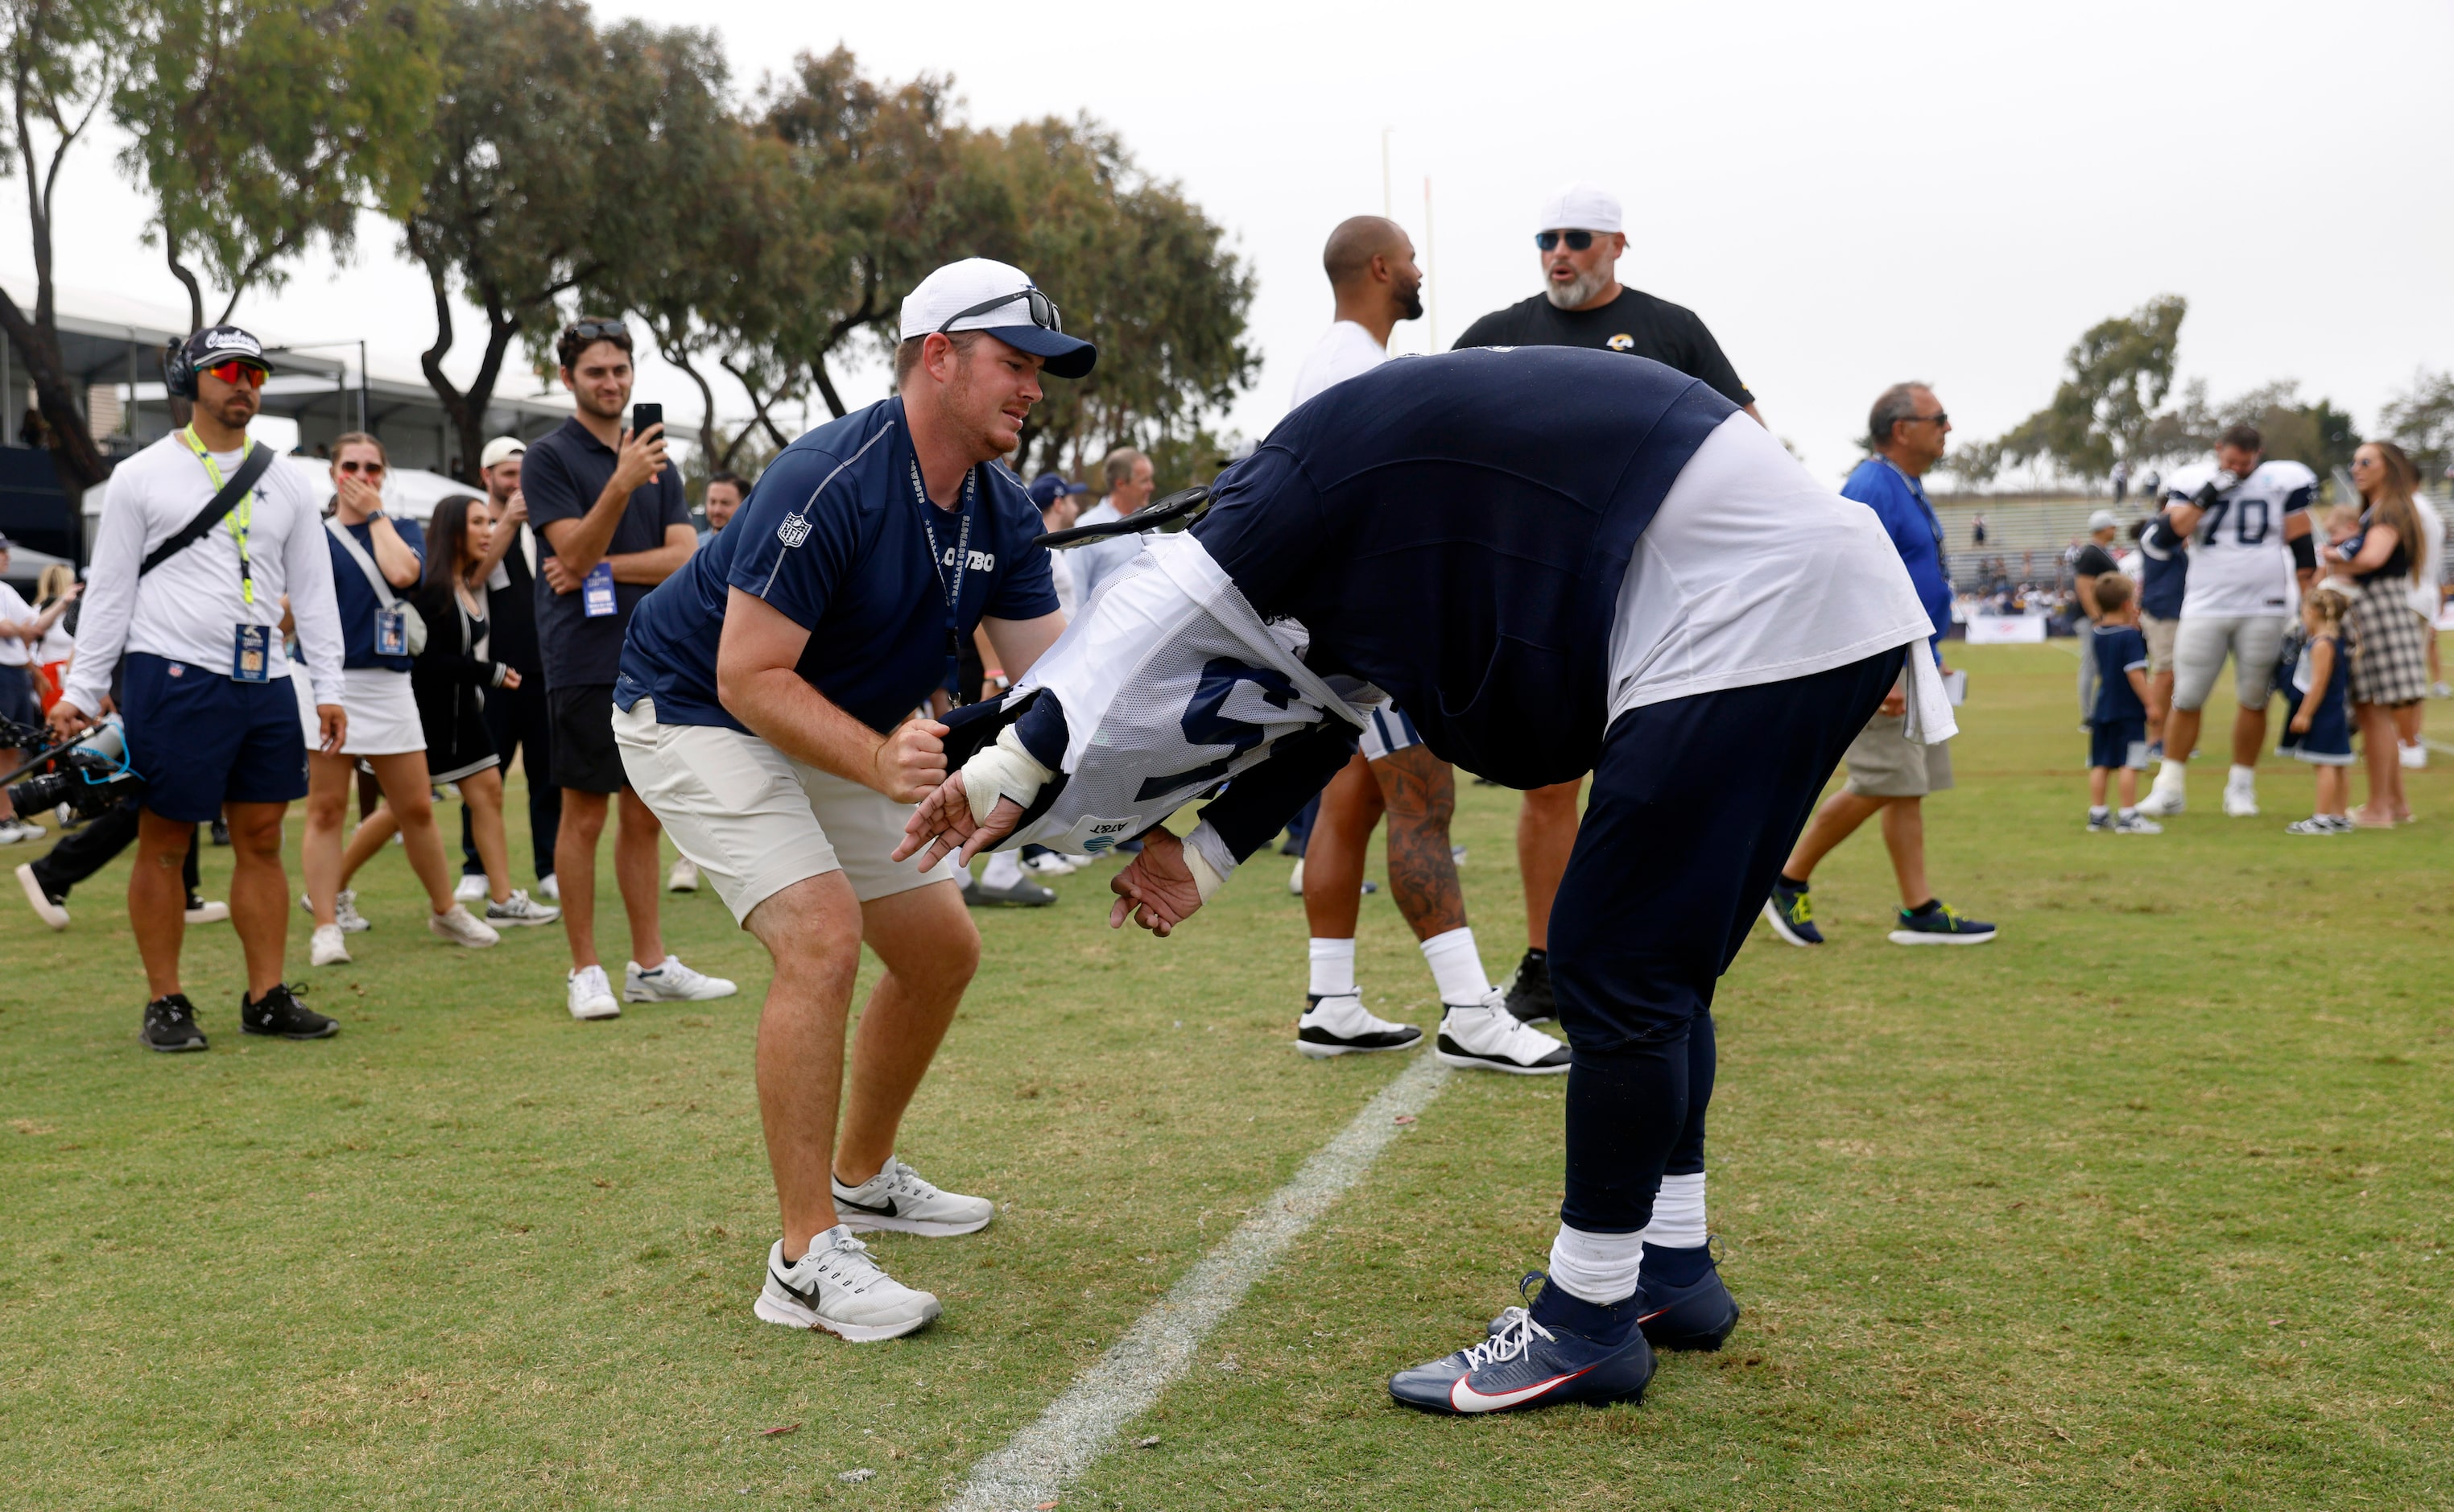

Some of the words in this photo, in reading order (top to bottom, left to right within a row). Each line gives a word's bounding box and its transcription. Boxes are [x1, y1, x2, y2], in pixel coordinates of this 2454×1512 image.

[957, 514, 971, 560] COWBOYS
[2204, 499, 2269, 545] 70
[951, 560, 964, 597] DALLAS
[1089, 821, 1129, 834] AT&T
